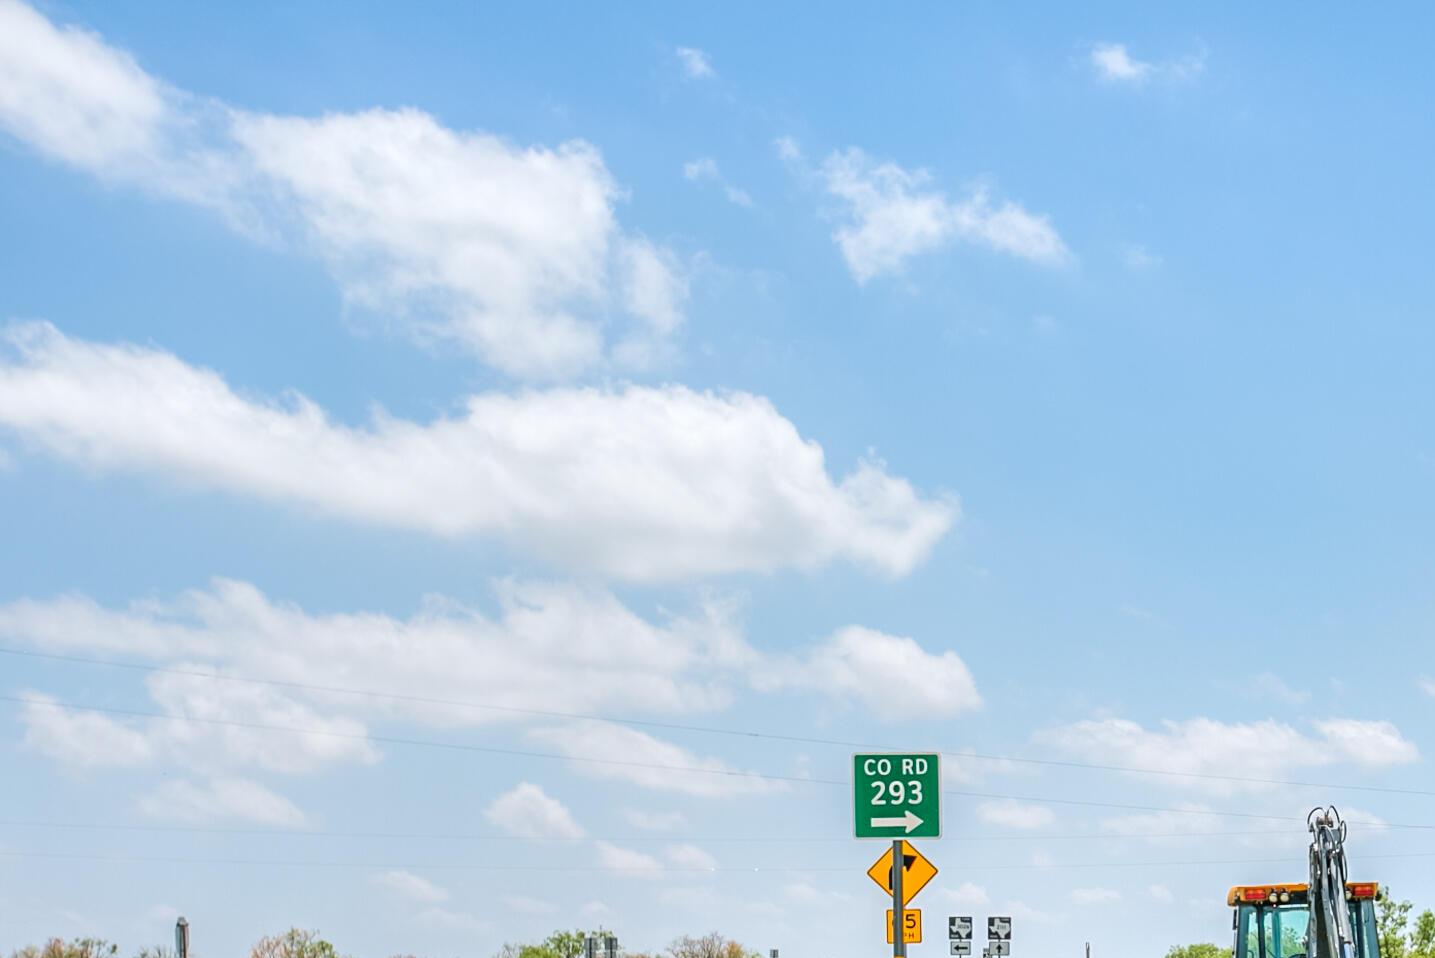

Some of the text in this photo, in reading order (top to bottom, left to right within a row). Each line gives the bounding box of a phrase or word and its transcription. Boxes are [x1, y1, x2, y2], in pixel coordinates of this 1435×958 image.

[863, 758, 928, 776] CO RD
[871, 780, 923, 806] 293
